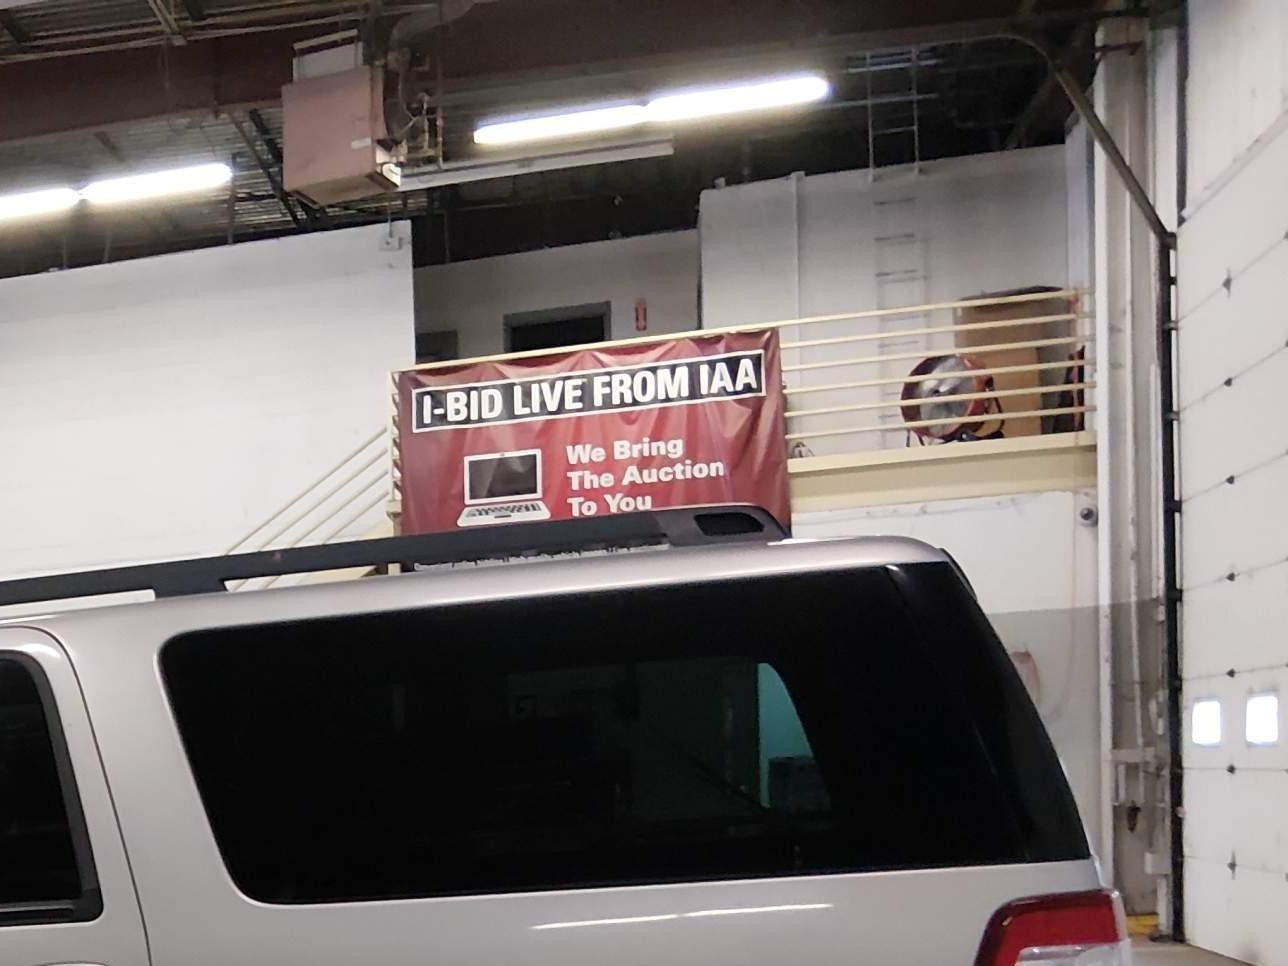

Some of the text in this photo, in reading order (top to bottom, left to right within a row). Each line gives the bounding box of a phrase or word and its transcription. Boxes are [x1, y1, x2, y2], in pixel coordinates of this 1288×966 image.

[423, 358, 758, 424] I-BID LIVE FROM IAA
[566, 437, 684, 465] We Bring
[566, 459, 725, 490] The Auction
[566, 493, 652, 517] To You
